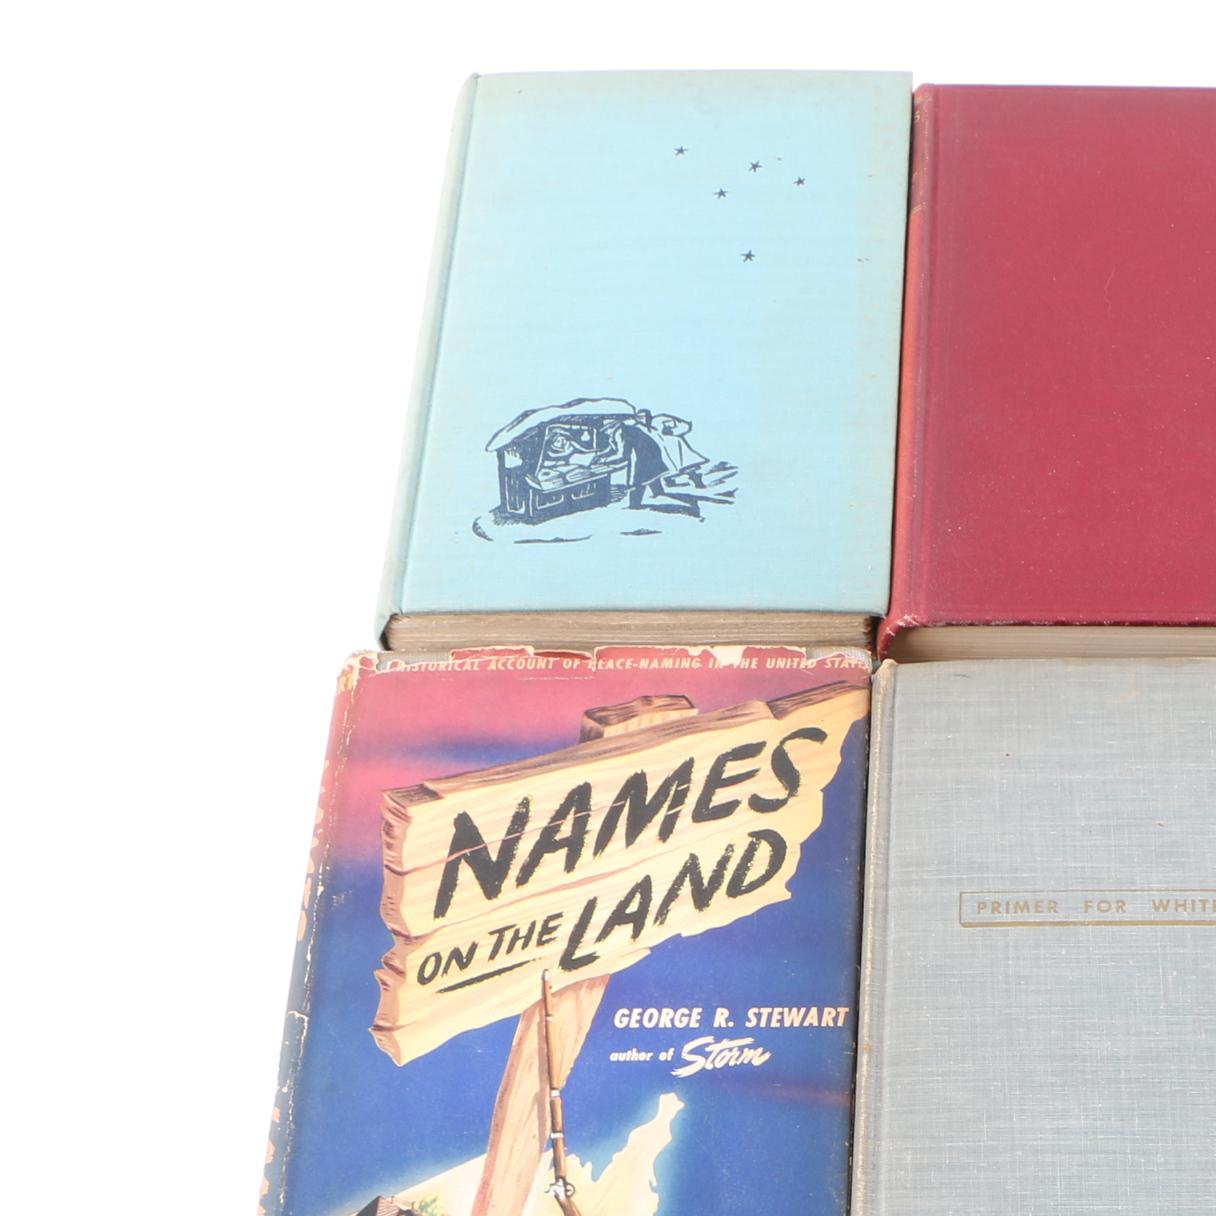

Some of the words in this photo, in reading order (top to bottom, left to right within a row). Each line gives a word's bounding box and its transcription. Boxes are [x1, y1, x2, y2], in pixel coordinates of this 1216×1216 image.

[488, 657, 555, 670] ACCOUNT
[562, 658, 580, 669] OF
[766, 656, 817, 669] UNITED
[433, 726, 829, 920] NAMES
[417, 940, 478, 986] ON
[487, 912, 563, 962] THE
[558, 828, 788, 973] LAND
[976, 900, 1059, 915] PRIMER
[1084, 899, 1127, 914] FOR
[614, 1008, 702, 1029] GEORGE
[713, 1008, 735, 1028] R.
[745, 1007, 850, 1028] STEWART
[609, 1048, 654, 1063] author
[659, 1048, 676, 1062] of
[670, 1035, 772, 1078] Storm
